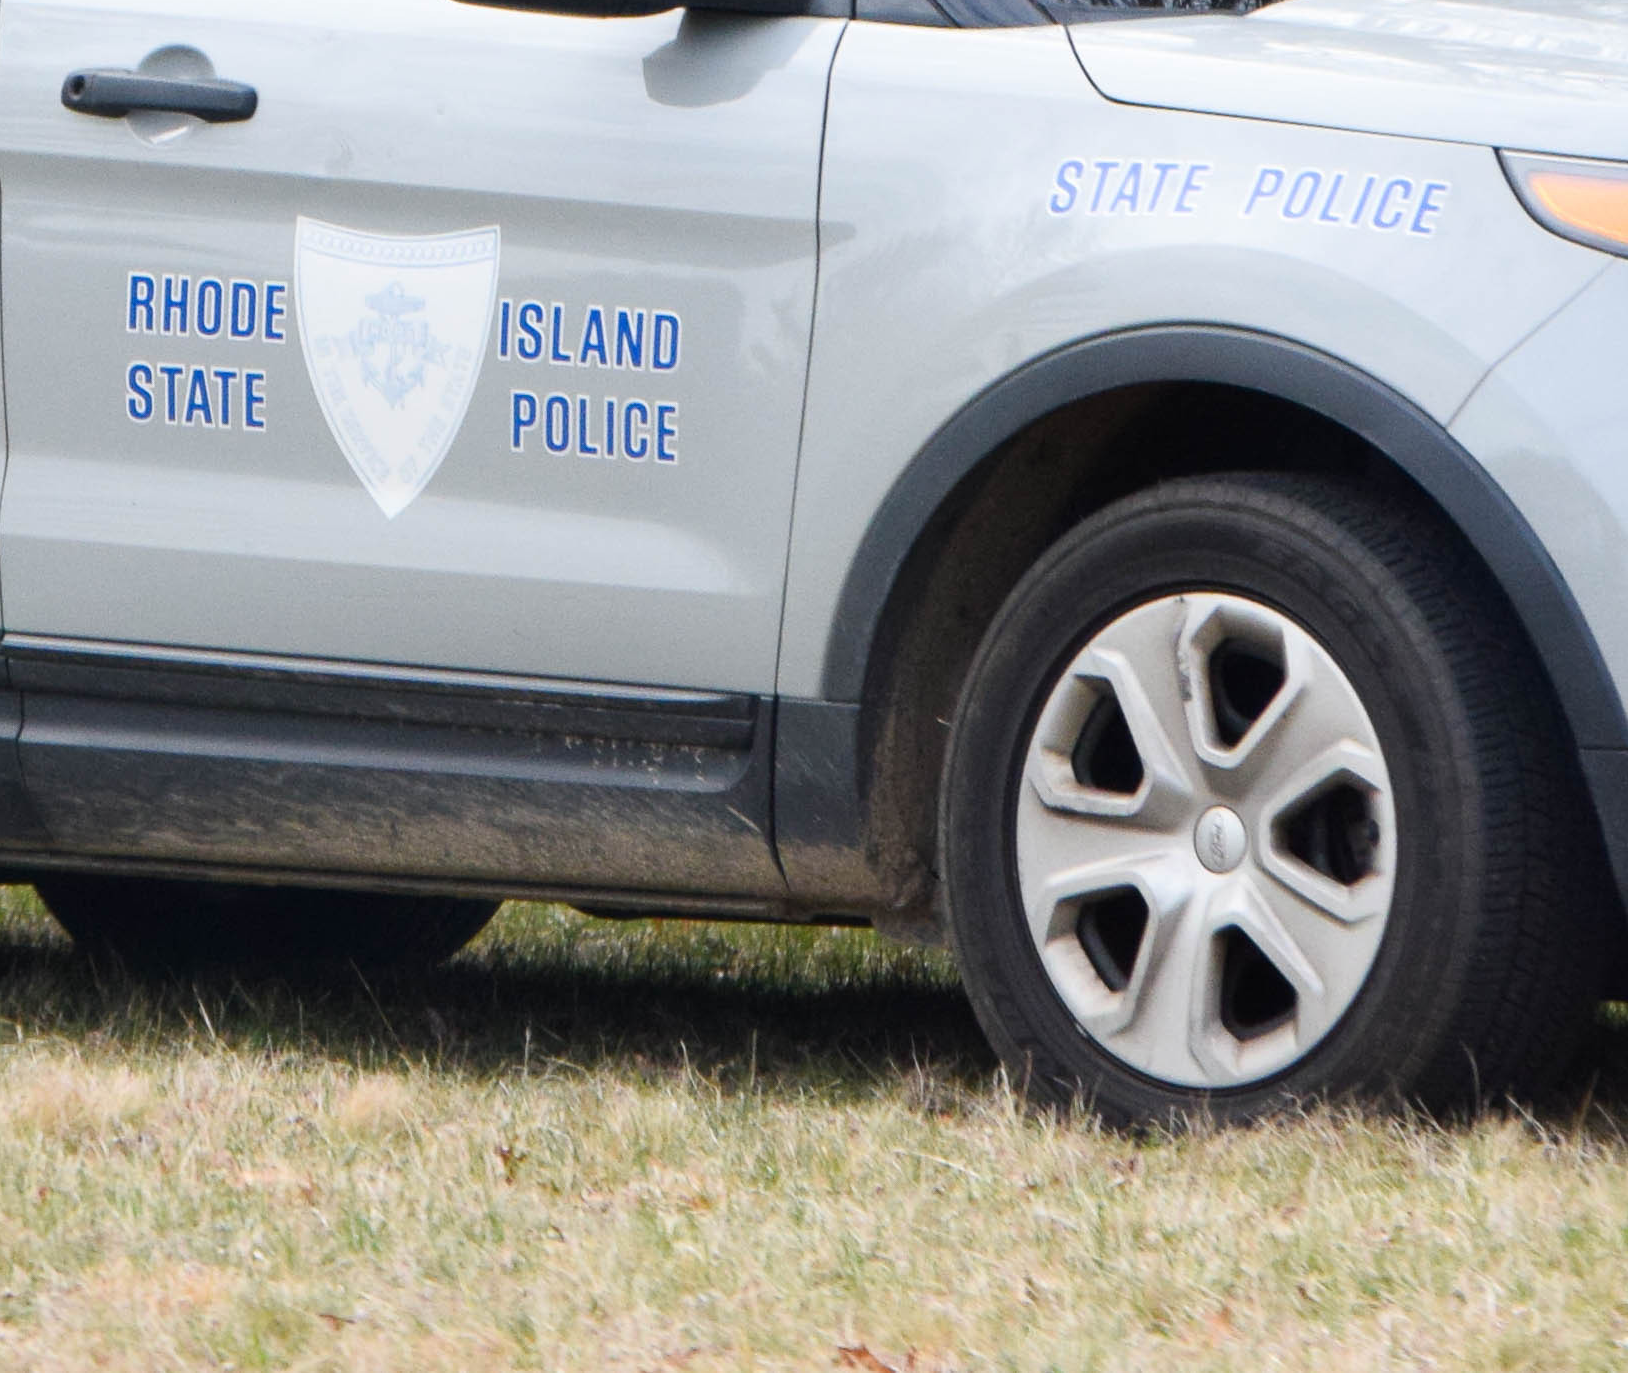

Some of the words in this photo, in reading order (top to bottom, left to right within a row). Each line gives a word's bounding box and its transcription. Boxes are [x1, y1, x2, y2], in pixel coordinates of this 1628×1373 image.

[1048, 158, 1212, 215] STATE
[1242, 166, 1450, 236] POLICE
[126, 272, 288, 343] RHODE
[497, 299, 683, 373] ISLAND
[126, 362, 268, 431] STATE
[510, 391, 679, 464] POLICE
